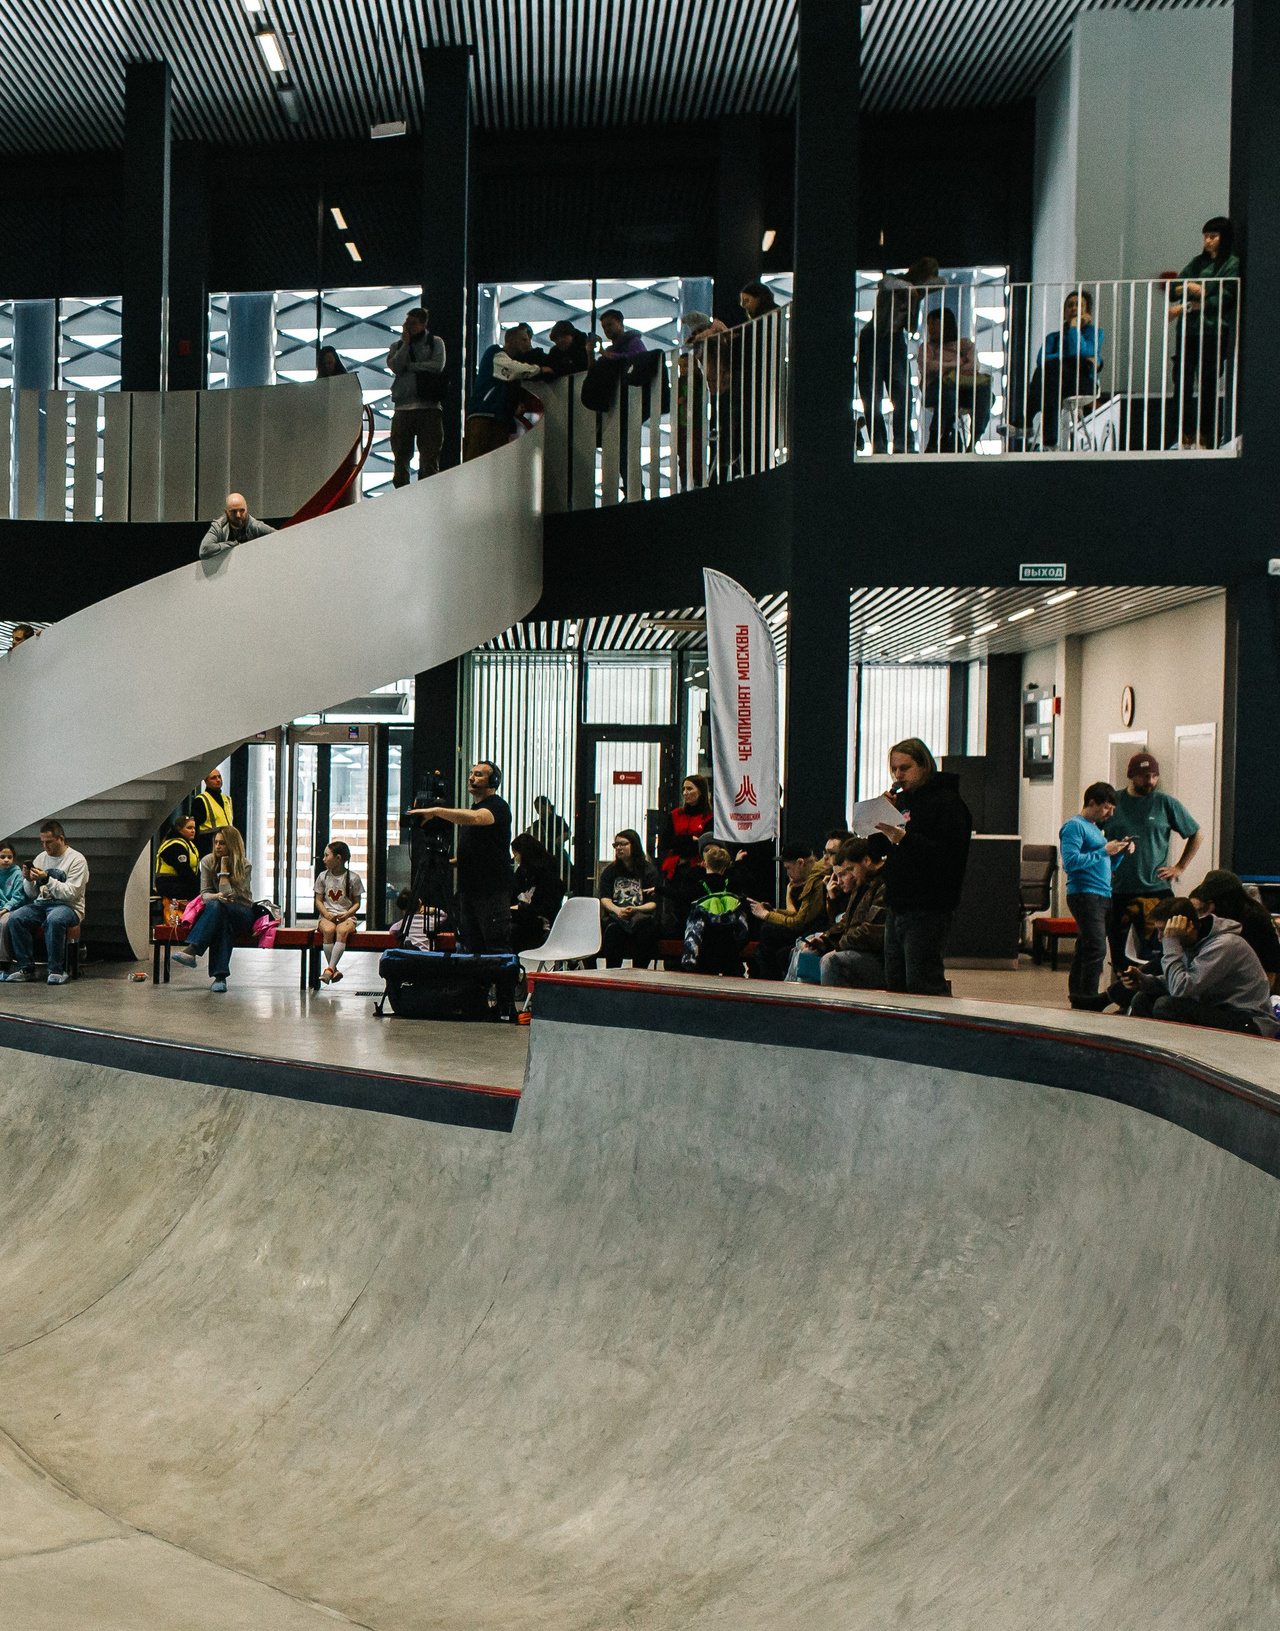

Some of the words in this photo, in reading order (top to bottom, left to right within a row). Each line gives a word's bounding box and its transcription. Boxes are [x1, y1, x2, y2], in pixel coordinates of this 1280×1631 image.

[1024, 568, 1063, 577] ВЫХОД
[735, 624, 750, 680] МОСКВЫ
[737, 684, 752, 762] ЧЕМПИОНАТ
